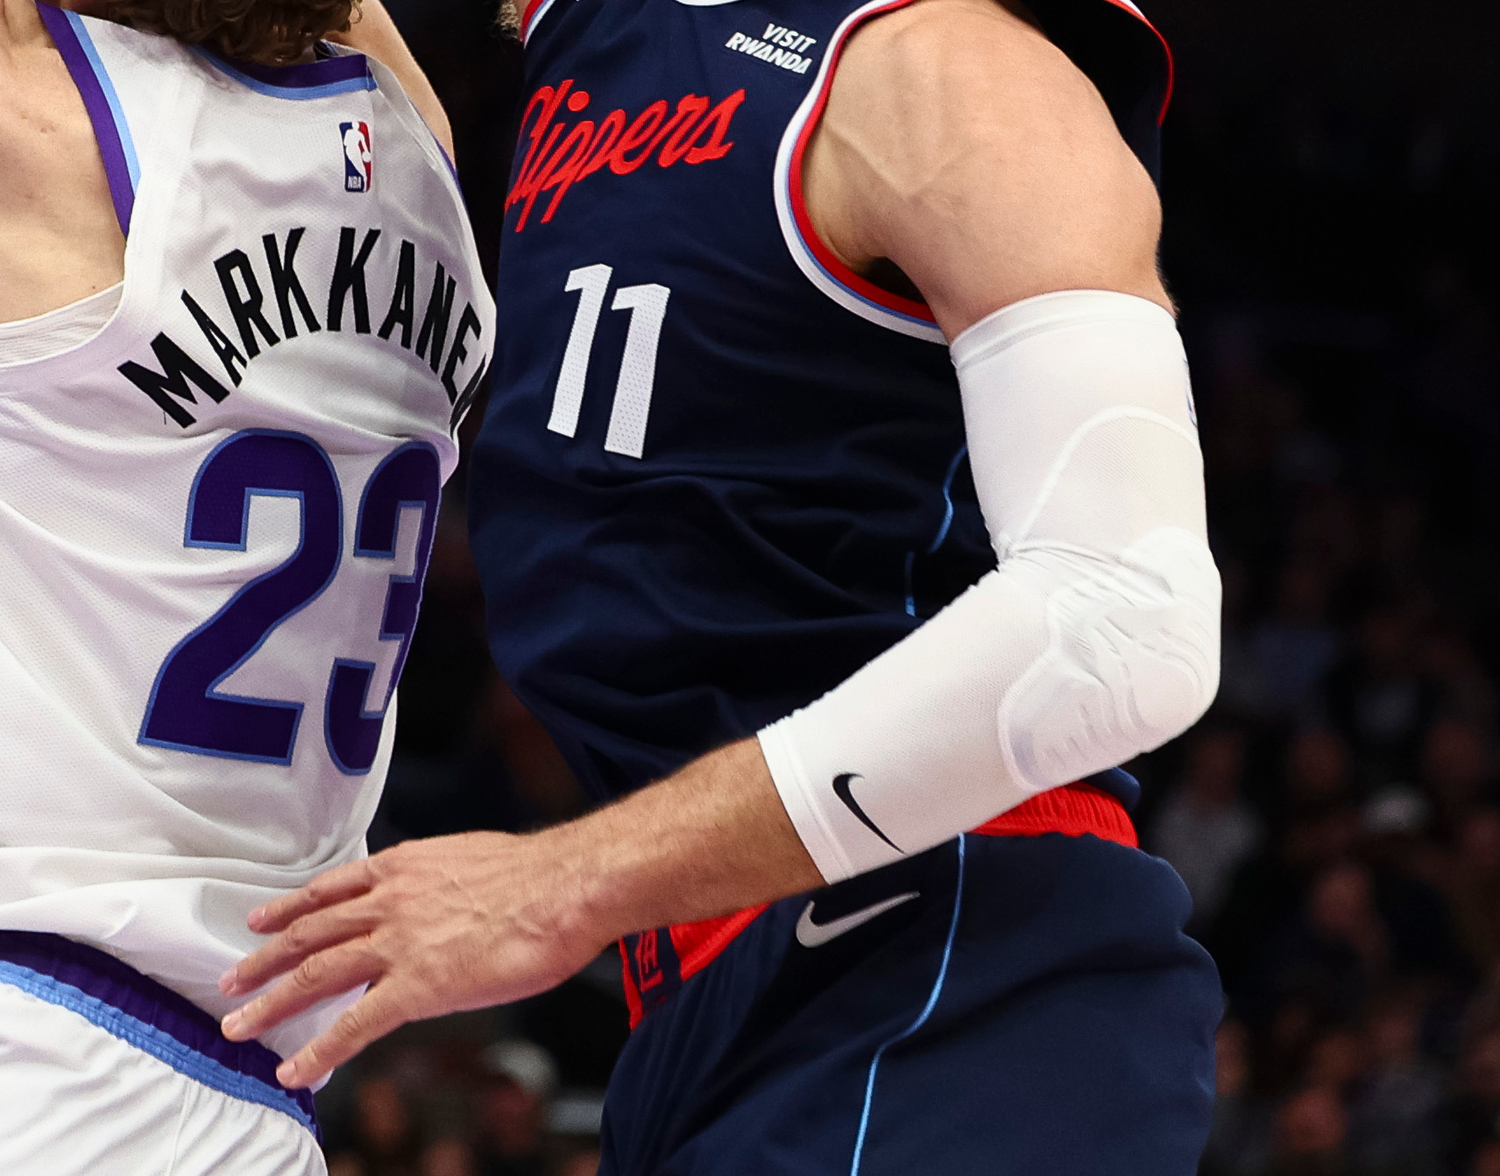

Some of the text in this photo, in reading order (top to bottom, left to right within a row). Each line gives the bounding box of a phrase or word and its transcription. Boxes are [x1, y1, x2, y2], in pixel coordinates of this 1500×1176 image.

[725, 32, 813, 74] RWANDA
[762, 23, 817, 53] VISIT
[547, 263, 671, 459] 11
[137, 428, 442, 775] 23
